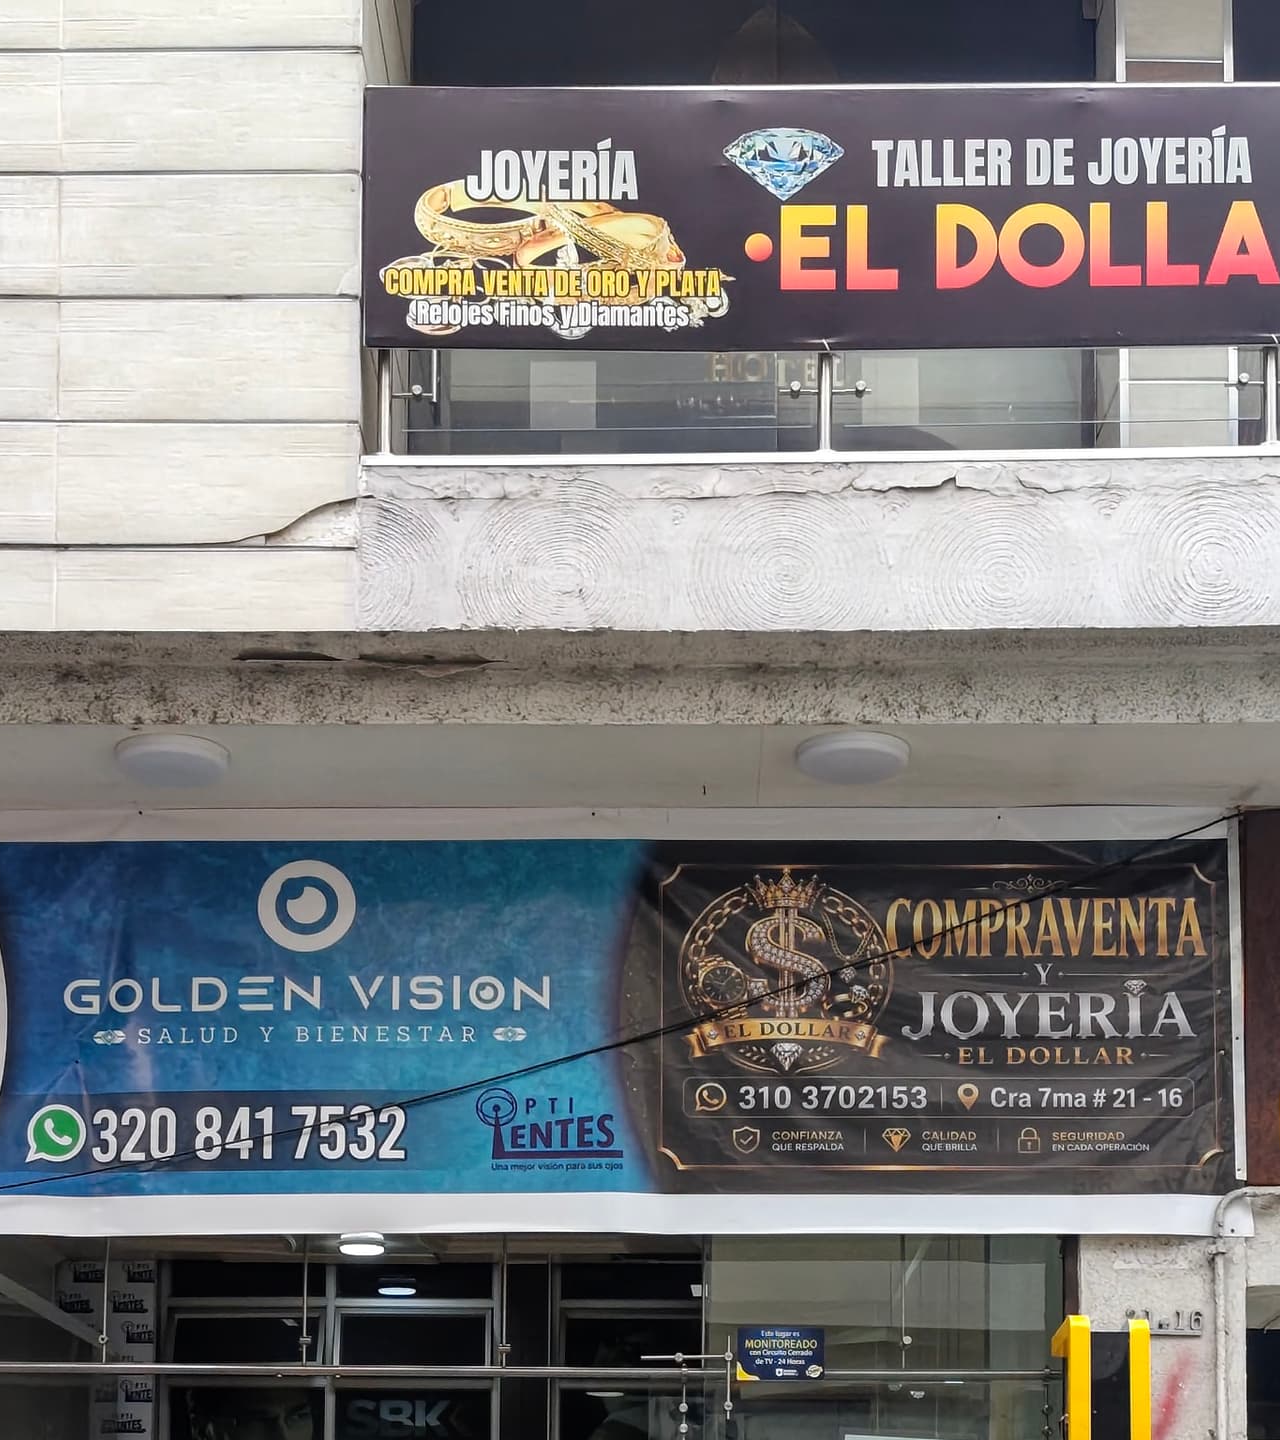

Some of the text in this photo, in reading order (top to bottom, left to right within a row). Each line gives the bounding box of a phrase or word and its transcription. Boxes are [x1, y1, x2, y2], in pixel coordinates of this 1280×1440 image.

[872, 125, 1252, 187] TALLER DE JOYERÍA
[465, 138, 639, 201] JOYERÍA
[781, 204, 899, 291] EL
[384, 267, 722, 297] COMPRA VENTA DE ORO Y PLATA
[417, 301, 495, 327] Relojes
[498, 300, 554, 326] Finos
[885, 896, 1208, 960] COMPRAVENTA
[1032, 963, 1054, 986] Y
[63, 975, 552, 1015] GOLDEN VISION
[137, 1025, 479, 1045] SALUD Y BIENESTAR
[724, 1021, 852, 1041] EL DOLLAR
[959, 1046, 1135, 1065] EL DOLLAR
[738, 1086, 928, 1110] 310 3702153
[990, 1087, 1184, 1109] Cra 7ma # 21 16
[91, 1104, 407, 1164] 320 841 7532
[771, 1130, 844, 1142] CONFIANZA
[921, 1130, 977, 1142] CALIDAD
[1051, 1130, 1125, 1142] SEGURIDAD
[771, 1142, 845, 1153] QUE RESPALDA
[921, 1142, 978, 1153] QUE BRILLA
[1066, 1142, 1093, 1152] CADA
[744, 1339, 818, 1349] MONITOREADO
